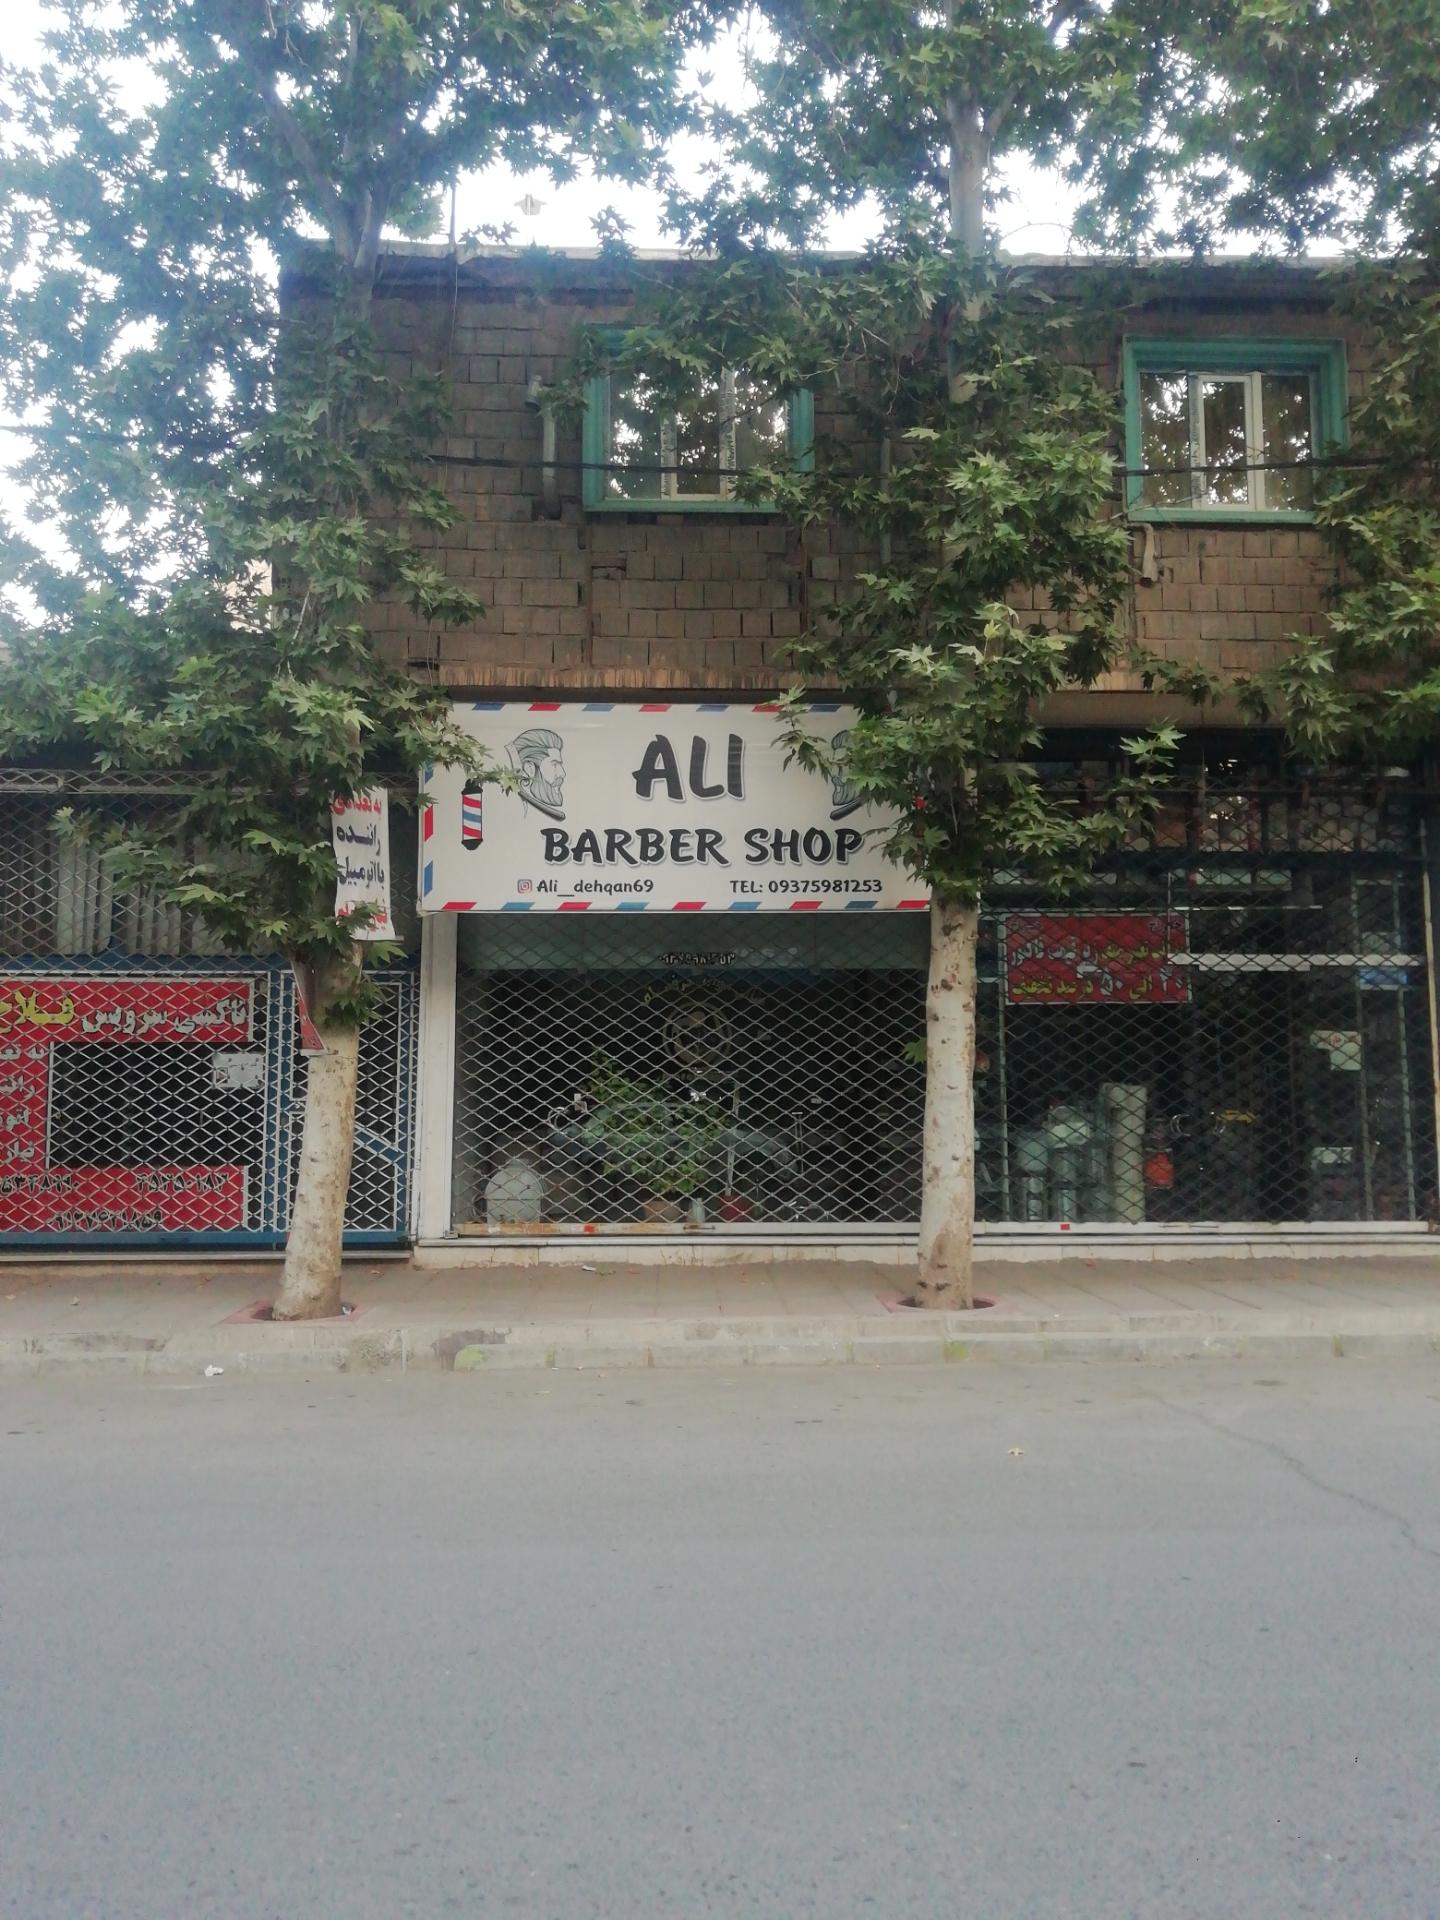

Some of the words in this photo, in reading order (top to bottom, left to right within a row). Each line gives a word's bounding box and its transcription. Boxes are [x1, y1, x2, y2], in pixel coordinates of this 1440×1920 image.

[632, 734, 743, 799] ALI
[336, 823, 381, 857] راننده
[540, 828, 730, 866] BARBER
[744, 827, 863, 865] SHOP
[730, 880, 763, 893] TEL:
[768, 879, 883, 893] 09375981253
[80, 1006, 168, 1036] سرویس
[174, 996, 247, 1035] تاکسی
